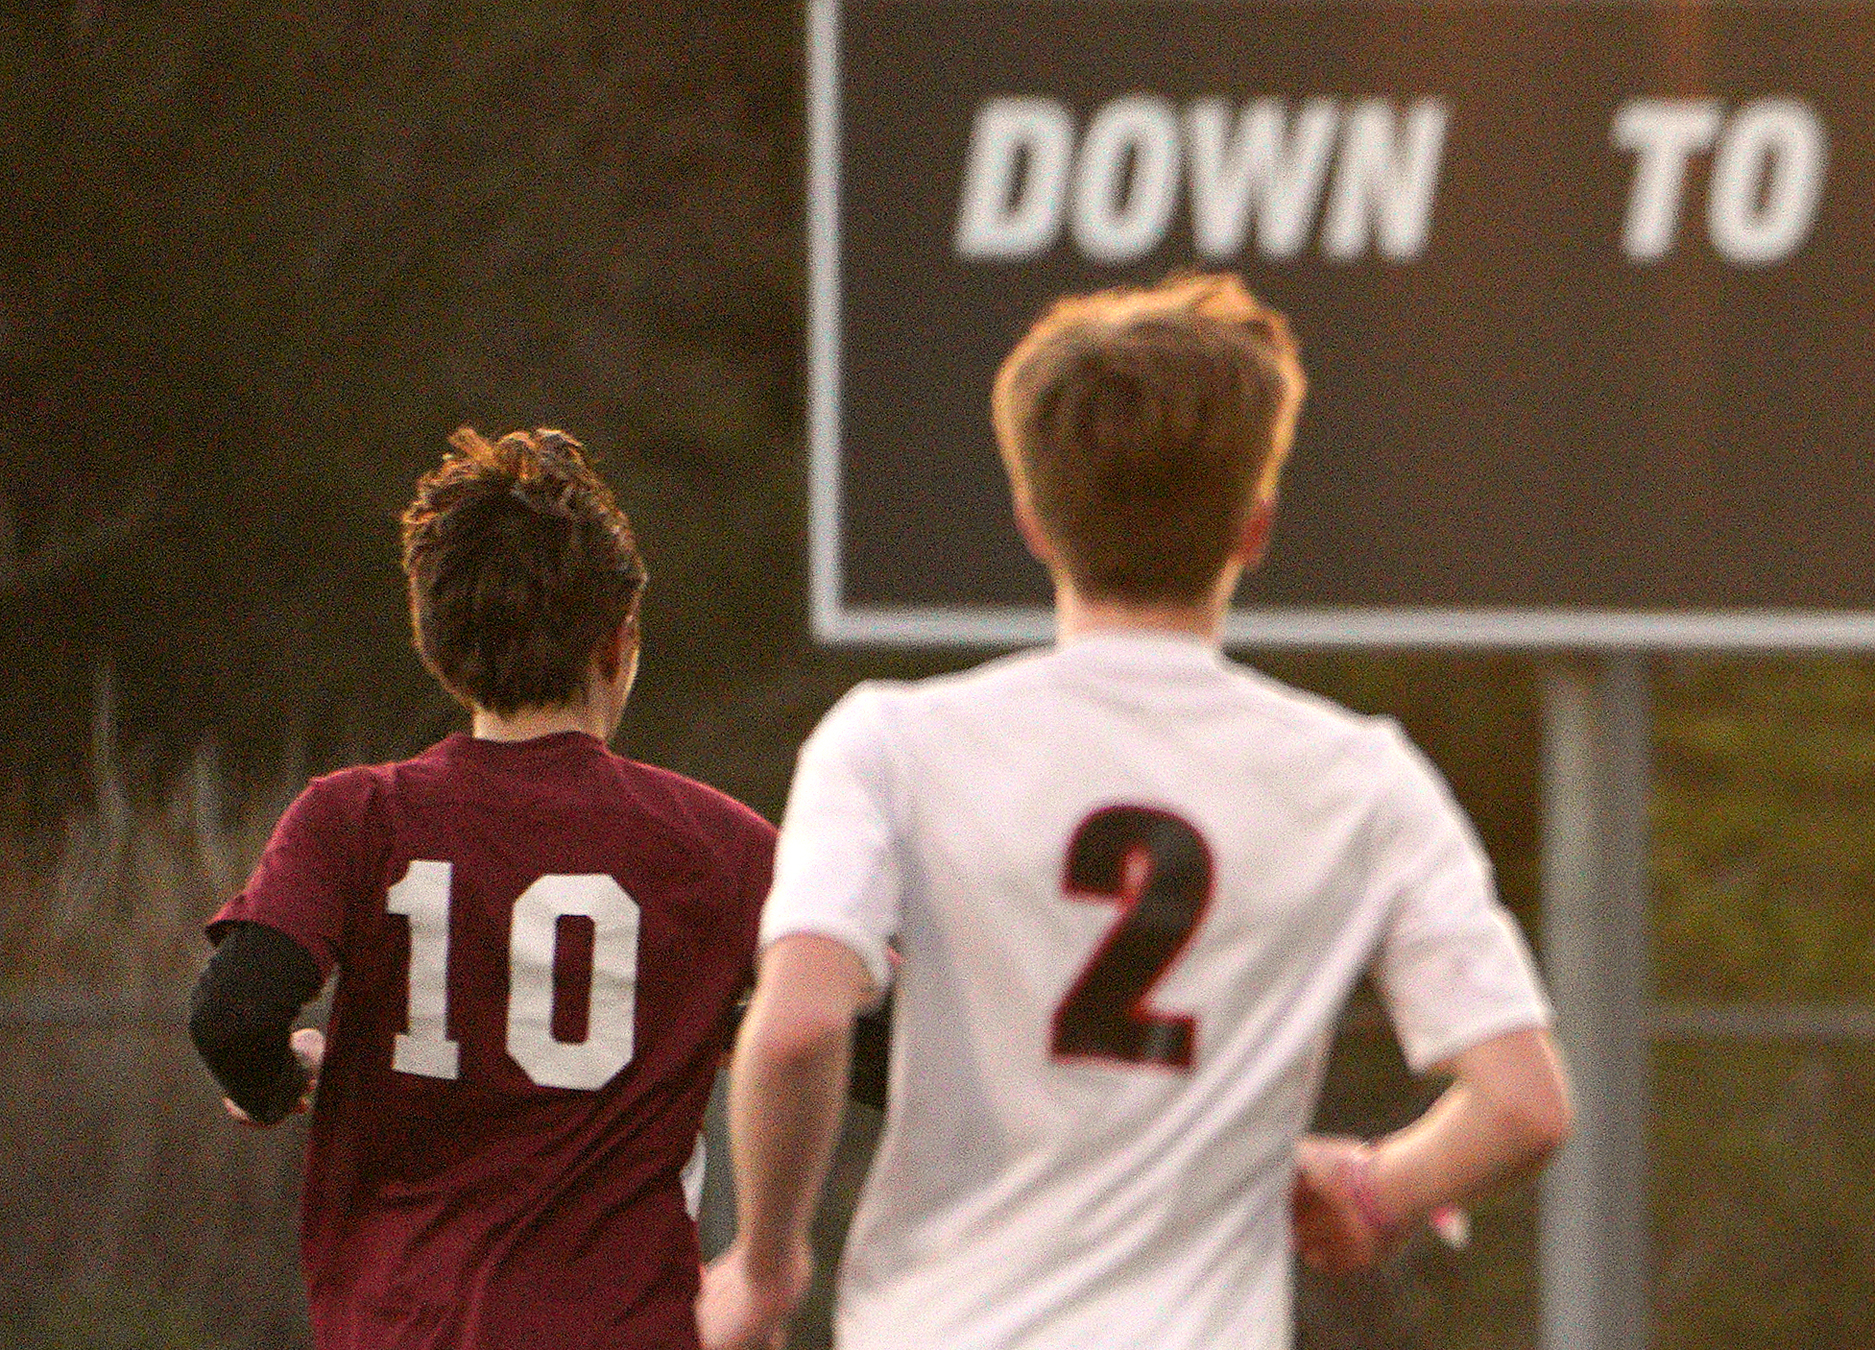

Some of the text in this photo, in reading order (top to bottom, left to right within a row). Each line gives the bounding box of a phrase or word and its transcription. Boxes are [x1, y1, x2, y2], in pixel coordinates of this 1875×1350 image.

[954, 97, 1450, 263] DOWN
[1612, 99, 1828, 268] TO
[386, 858, 641, 1091] 10
[1049, 805, 1213, 1071] 2
